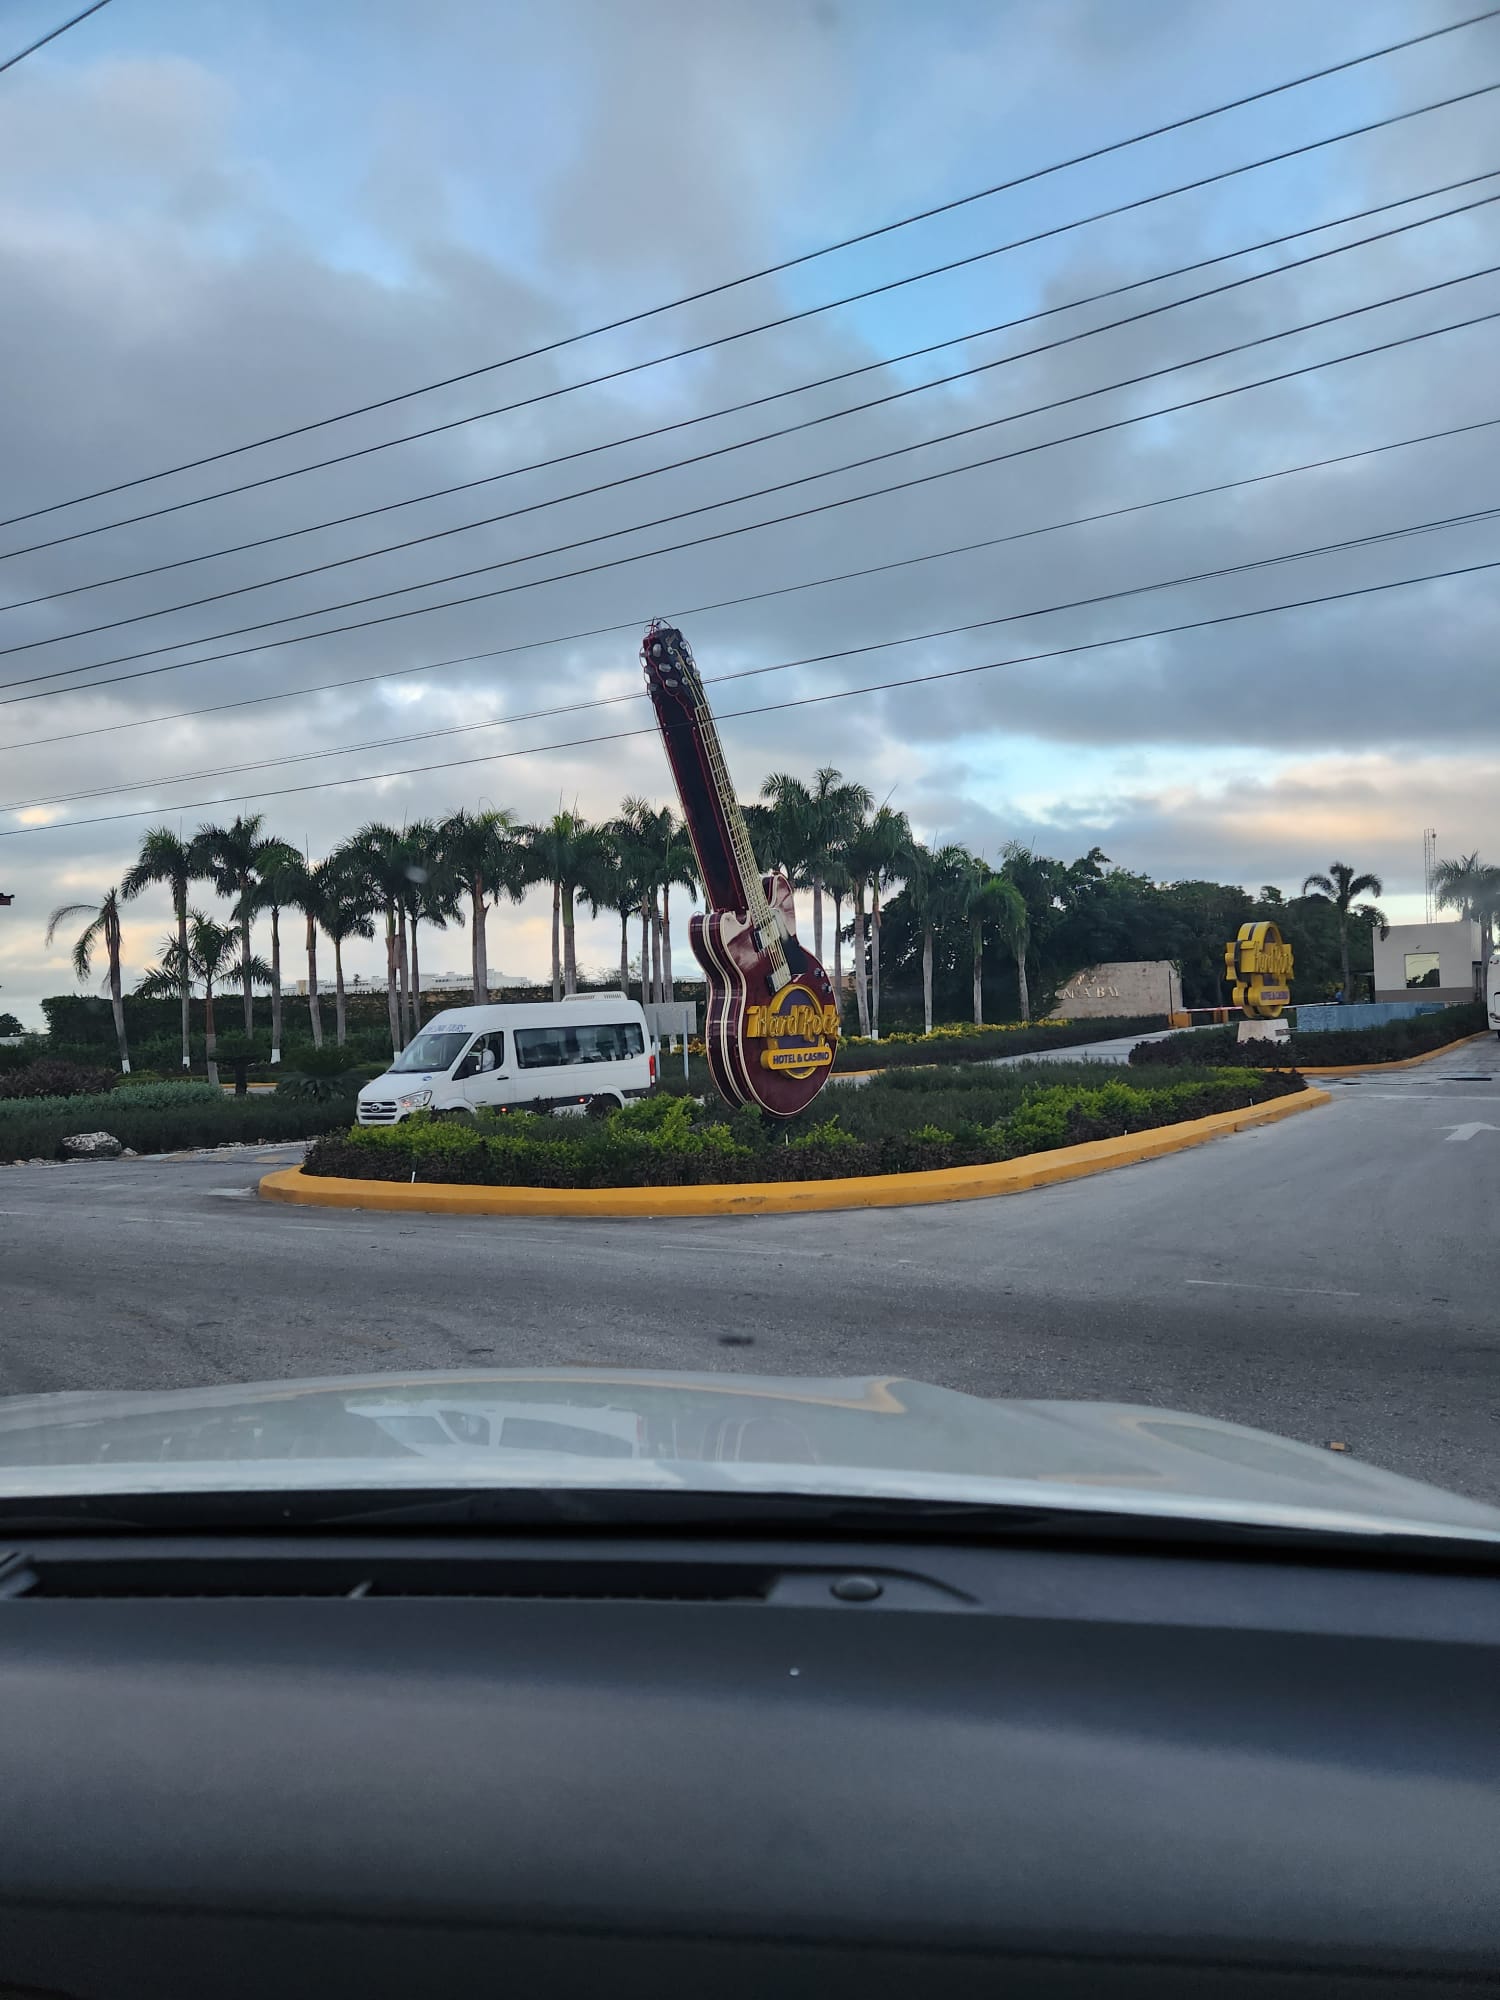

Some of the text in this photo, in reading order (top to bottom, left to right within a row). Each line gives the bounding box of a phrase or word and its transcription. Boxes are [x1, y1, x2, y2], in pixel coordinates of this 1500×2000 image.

[748, 1004, 840, 1042] Hard Rock
[773, 1052, 829, 1064] HOTEL & CASINO
